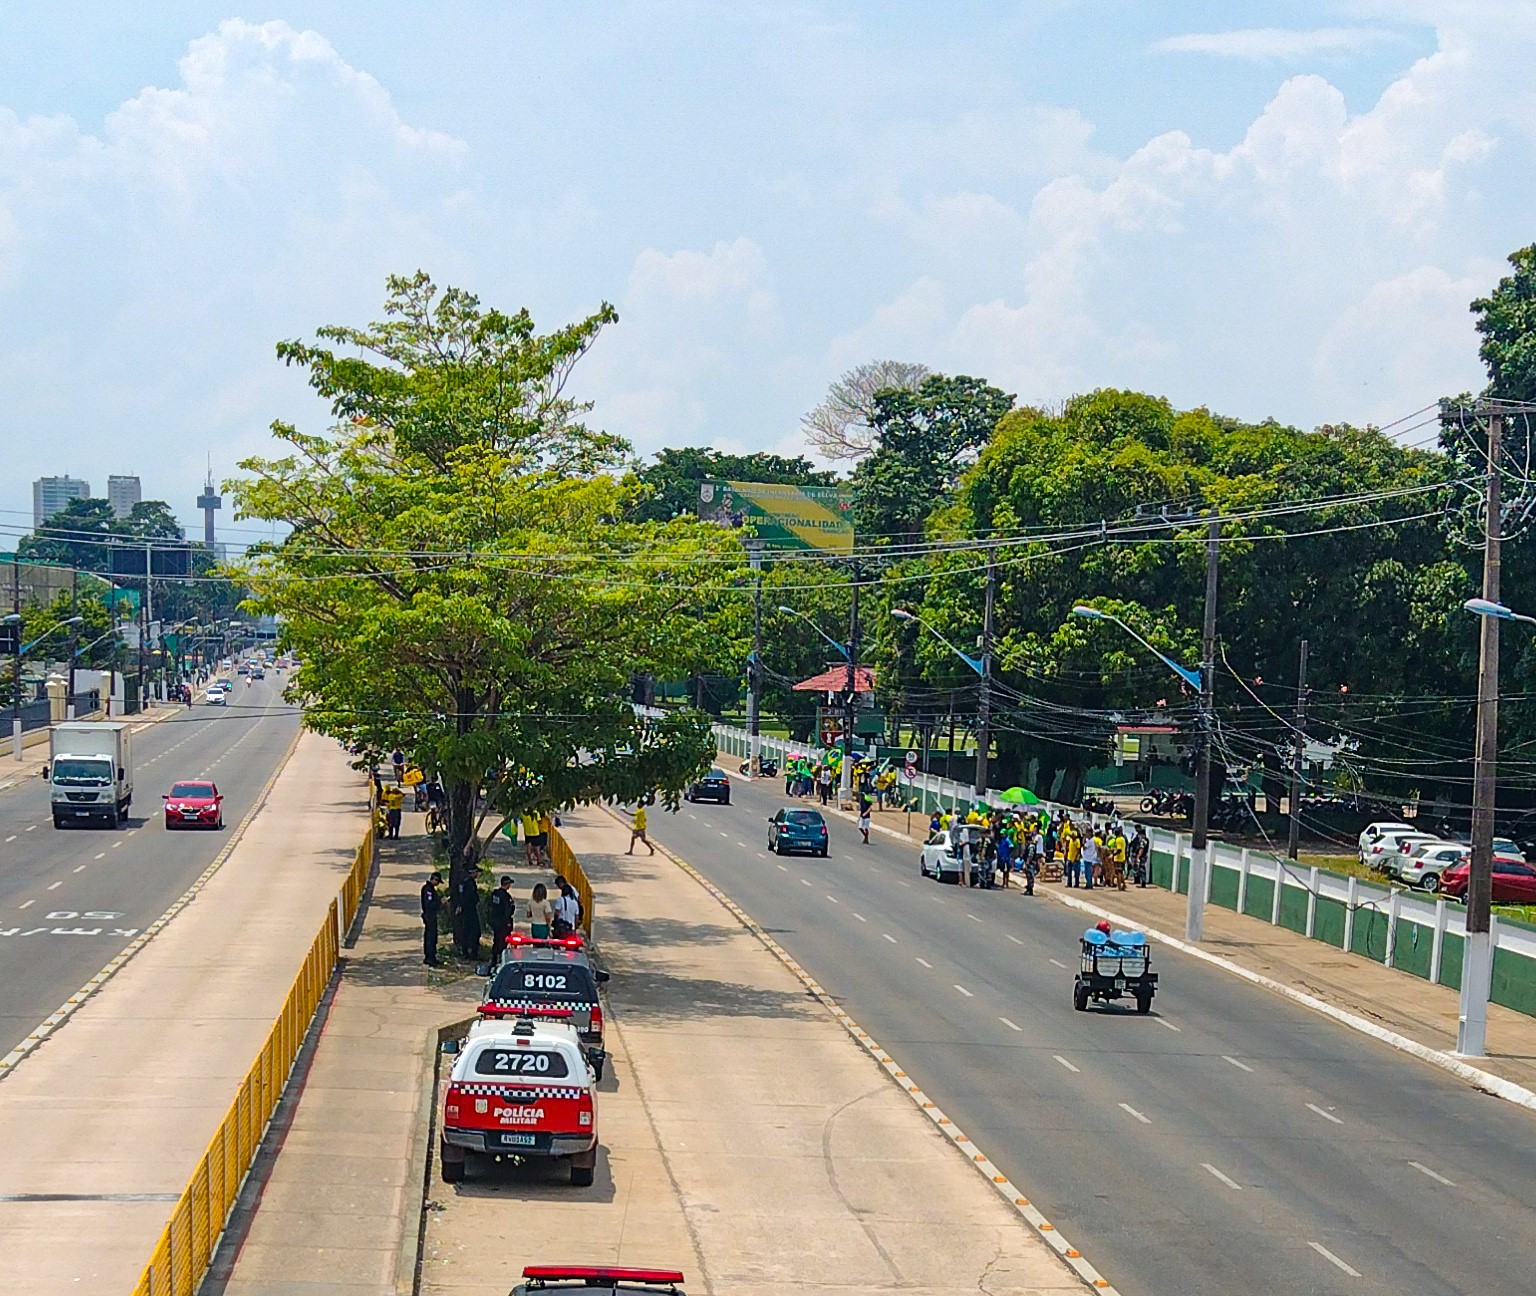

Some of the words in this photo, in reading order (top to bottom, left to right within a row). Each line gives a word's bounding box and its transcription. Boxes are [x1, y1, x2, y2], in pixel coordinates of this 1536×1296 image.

[742, 516, 850, 528] OPERACIONALIDAD
[44, 910, 125, 920] 50
[524, 974, 566, 989] 8102
[495, 1053, 549, 1072] 2720
[493, 1106, 545, 1118] POLÍCIA
[500, 1117, 538, 1125] MILITAR
